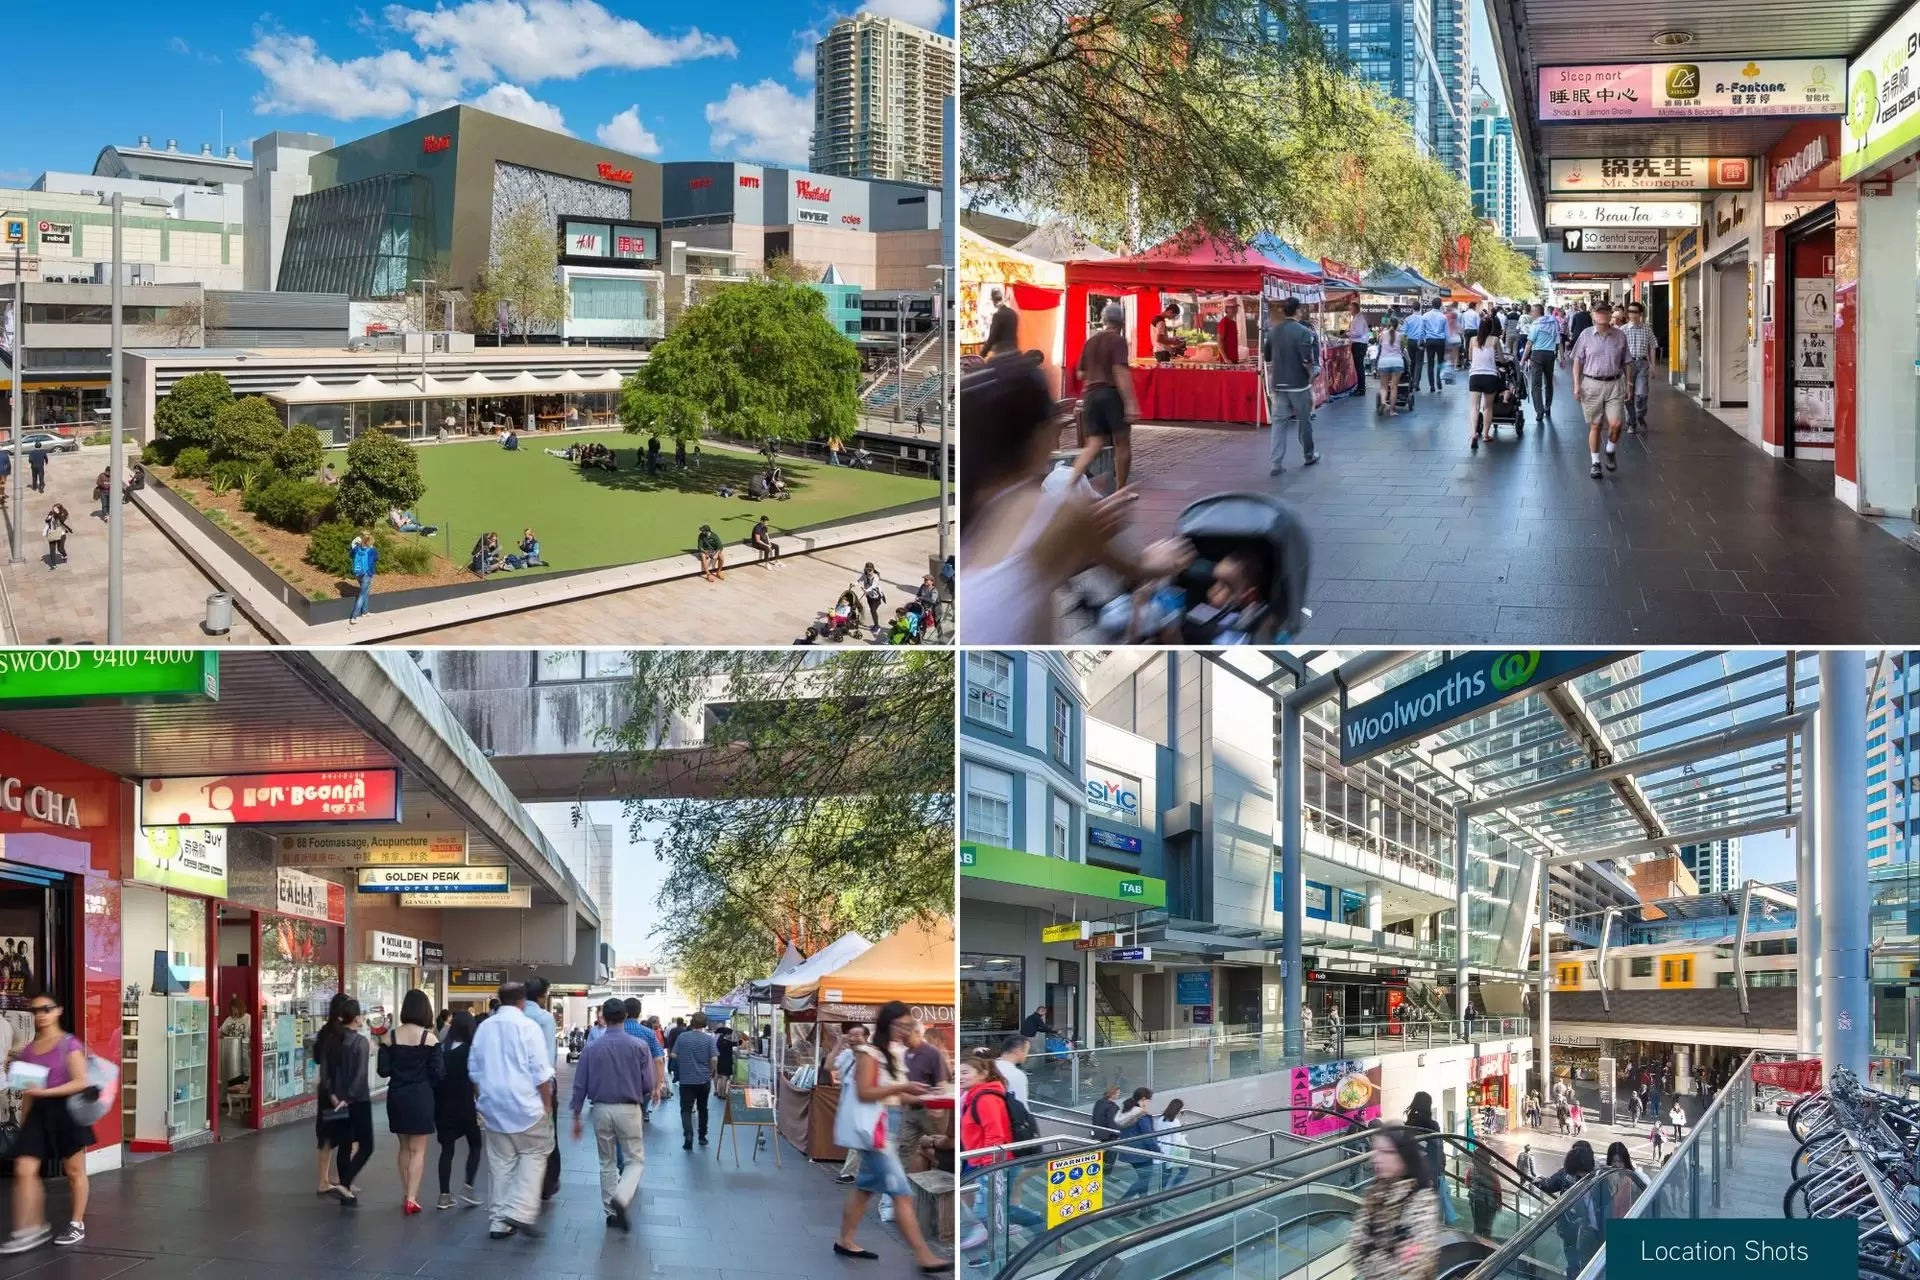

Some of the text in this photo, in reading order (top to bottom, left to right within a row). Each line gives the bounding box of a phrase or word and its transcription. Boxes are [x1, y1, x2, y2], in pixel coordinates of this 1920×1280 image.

[1560, 71, 1622, 84] Sleep mart
[1715, 82, 1786, 93] A-Fontane
[1549, 88, 1639, 104] 睡眠中心
[1586, 108, 1610, 116] Lemon
[1611, 107, 1633, 115] Grove
[1658, 108, 1687, 117] Mattress
[1695, 108, 1723, 116] Bedding
[1601, 158, 1692, 178] 锅先生
[1601, 178, 1696, 188] Mr. Stonepot
[796, 179, 832, 202] Westfield
[800, 211, 828, 222] MYER
[841, 215, 861, 225] coles
[49, 224, 73, 233] Target
[1584, 233, 1657, 244] SO dental surgery
[93, 650, 138, 669] 9410
[968, 686, 1008, 710] SMC
[1347, 669, 1486, 748] Woolworths
[1088, 780, 1137, 809] SMC
[31, 786, 81, 829] CHA
[297, 838, 306, 848] 88
[309, 837, 370, 849] Footmassage,
[371, 836, 428, 848] Acupuncture
[385, 871, 460, 882] GOLDEN PEAK
[1122, 882, 1142, 894] TAB
[1056, 1154, 1096, 1168] WARNING
